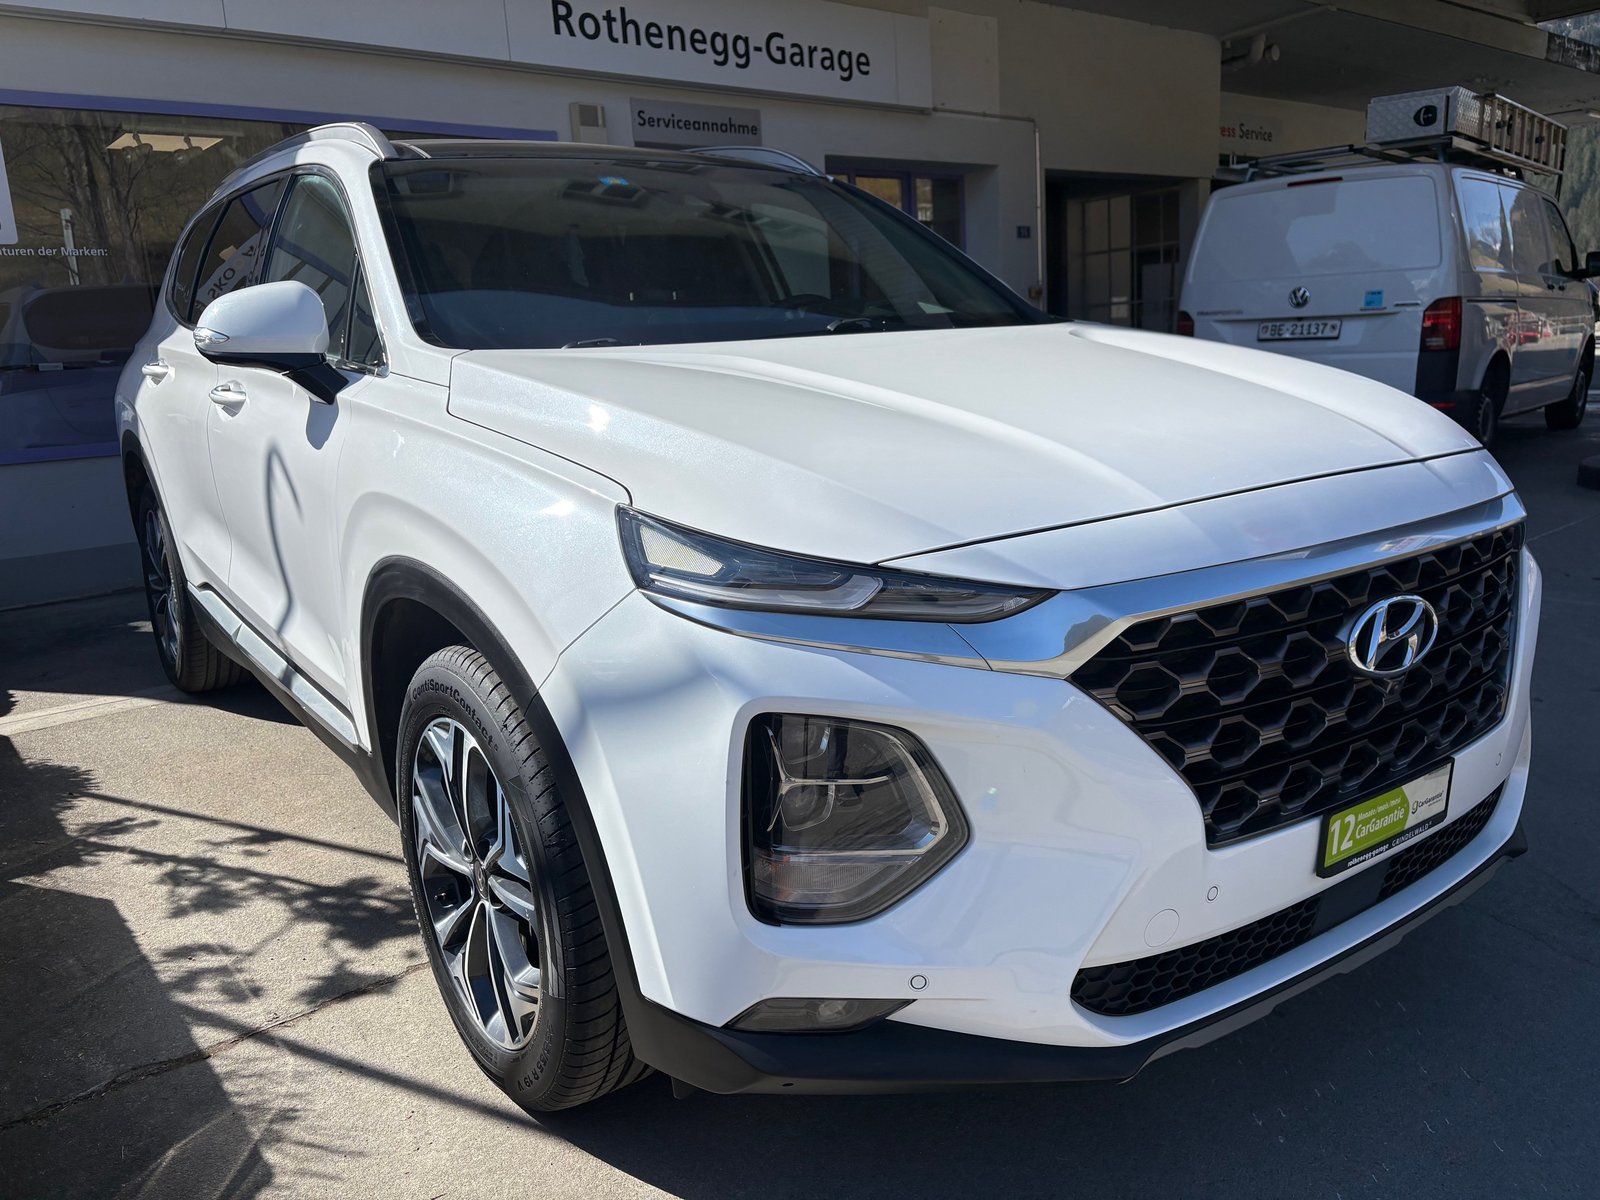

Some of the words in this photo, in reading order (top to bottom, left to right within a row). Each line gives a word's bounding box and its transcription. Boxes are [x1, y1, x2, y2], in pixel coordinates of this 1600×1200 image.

[551, 0, 871, 81] Rothenegg-Garage
[637, 110, 759, 136] Serviceannahme
[1219, 126, 1237, 138] ess
[1239, 123, 1273, 142] Service
[37, 246, 58, 257] der
[60, 246, 109, 257] Marken:
[1330, 814, 1356, 856] 12
[1355, 806, 1405, 839] CarGarantie
[1391, 823, 1429, 847] GRINDELWALD
